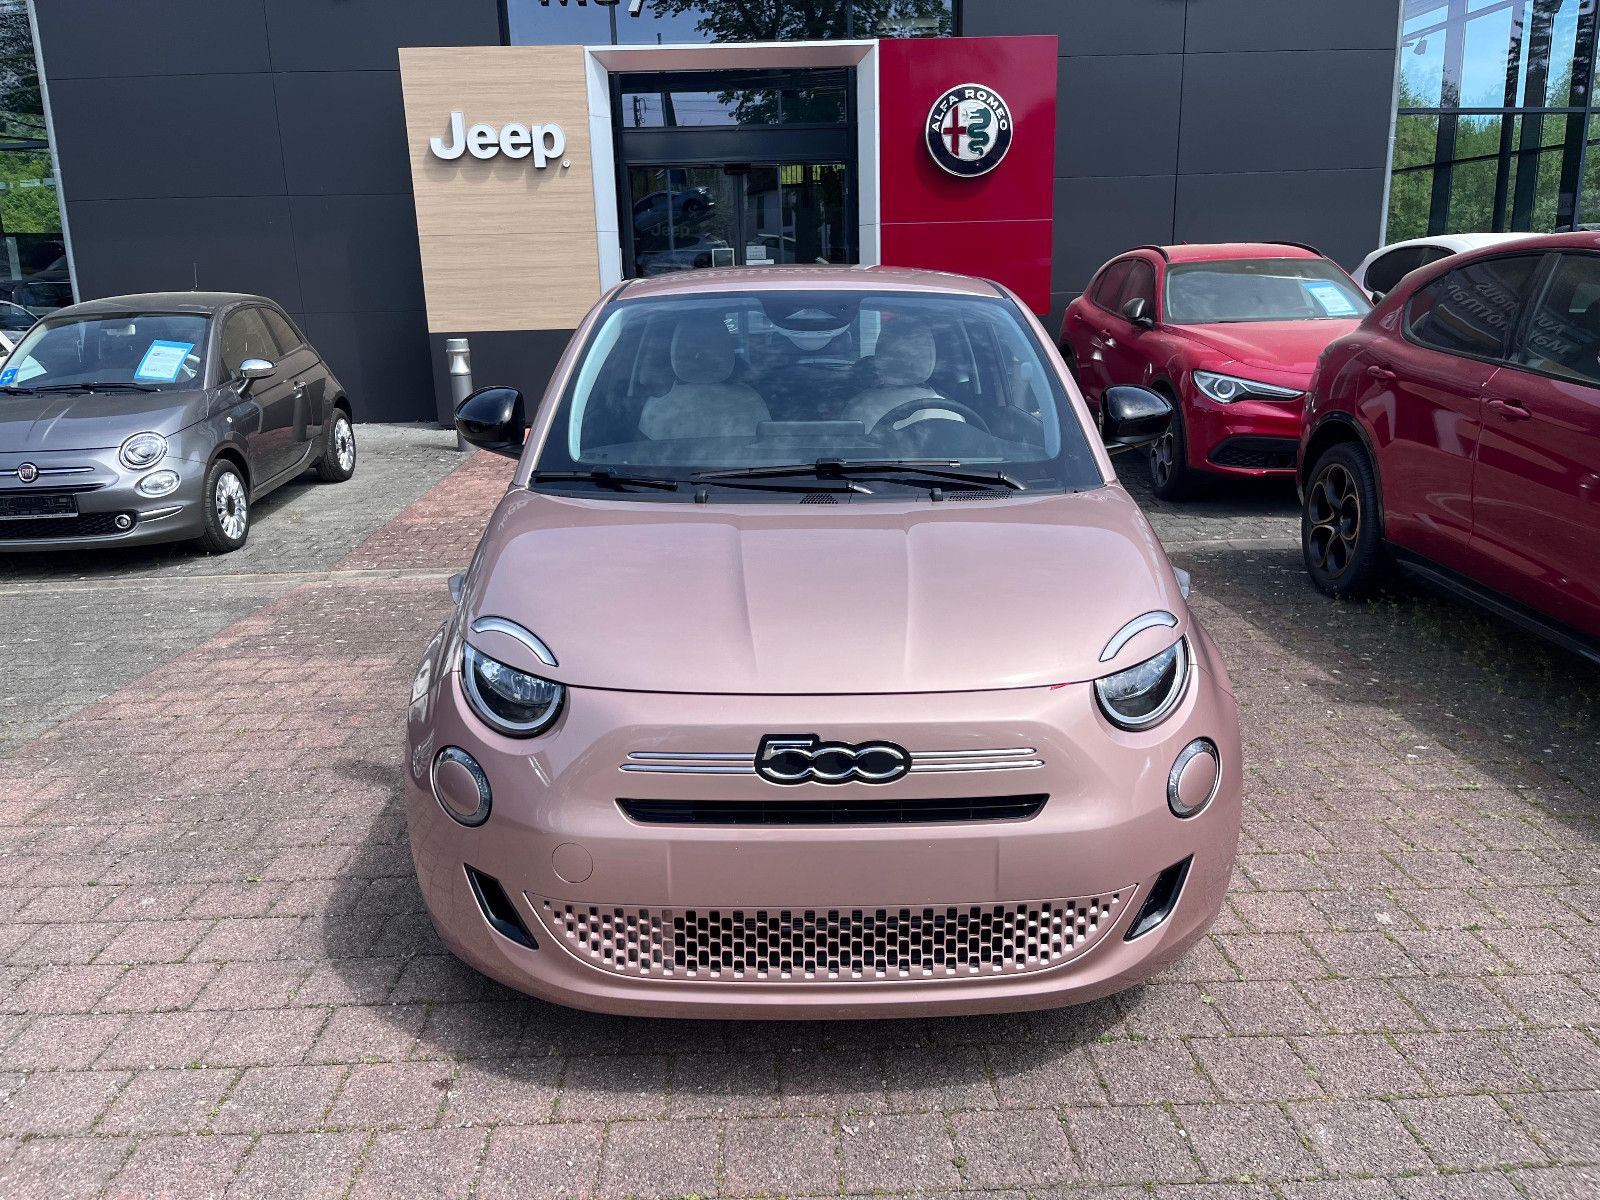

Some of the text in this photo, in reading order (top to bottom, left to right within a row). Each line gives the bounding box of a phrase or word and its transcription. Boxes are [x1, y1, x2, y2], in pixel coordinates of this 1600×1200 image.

[931, 89, 1008, 133] ALFA ROMEO
[430, 111, 566, 169] Jeep
[21, 468, 33, 478] FIAT
[756, 735, 911, 784] 500
